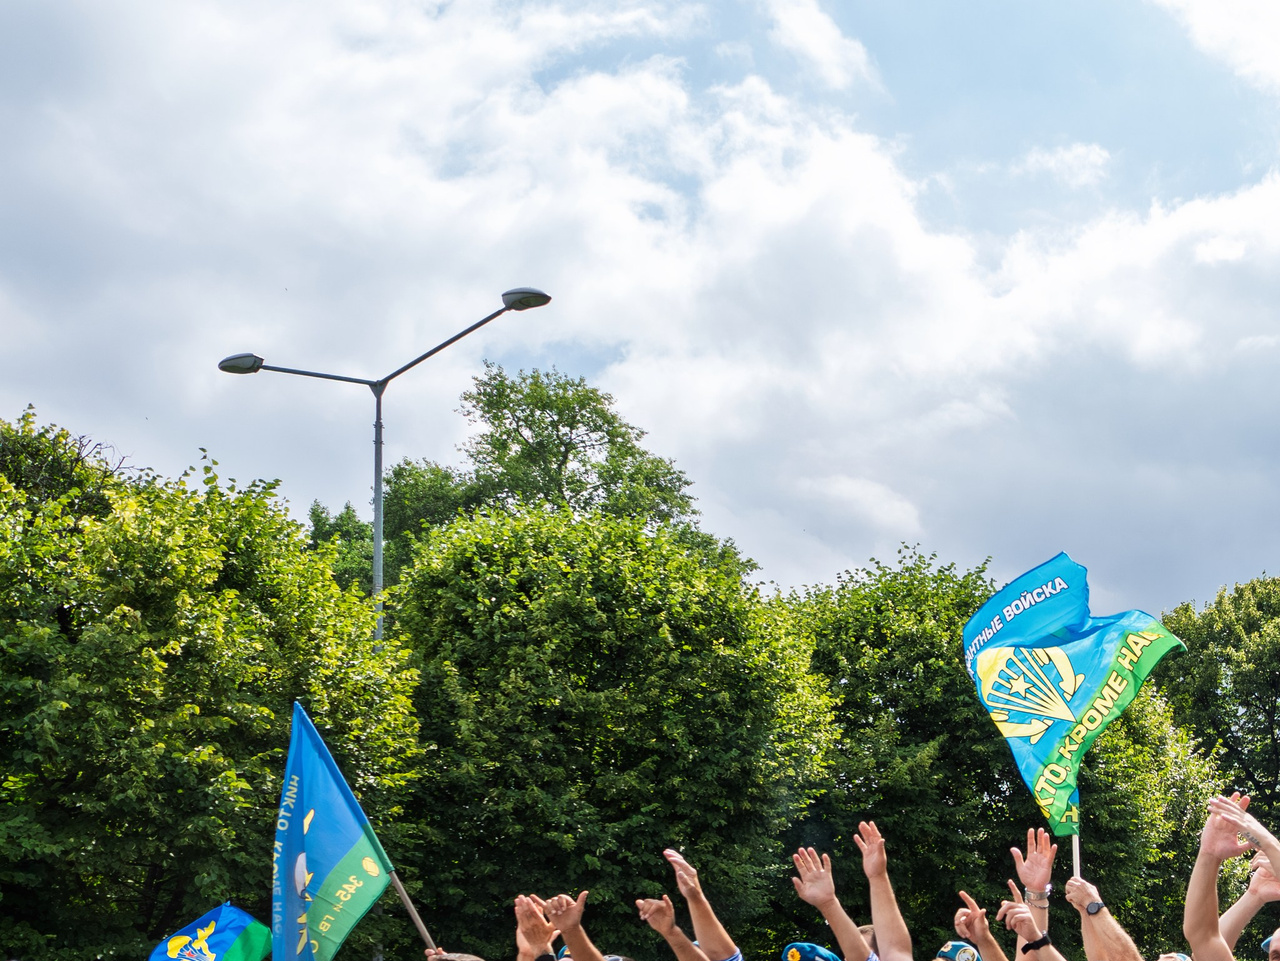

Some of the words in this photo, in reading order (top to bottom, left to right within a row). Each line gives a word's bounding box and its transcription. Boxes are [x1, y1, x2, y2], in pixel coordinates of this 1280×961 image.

[1003, 576, 1069, 623] ВОЙСКА
[1033, 762, 1072, 816] КТО,
[1058, 670, 1129, 760] КРОМЕ
